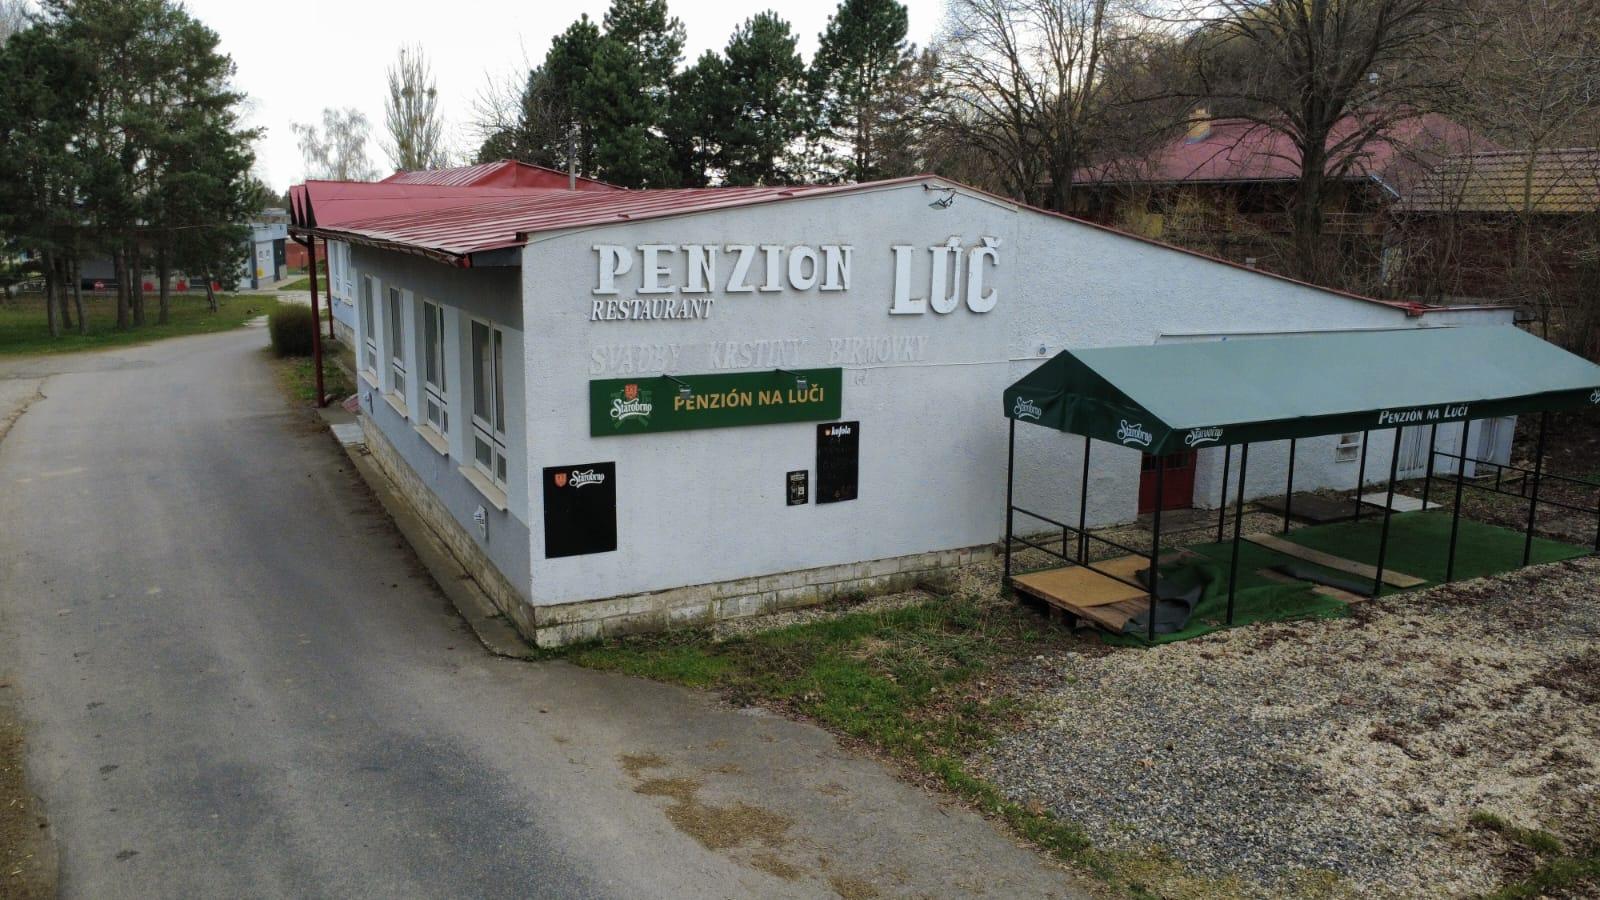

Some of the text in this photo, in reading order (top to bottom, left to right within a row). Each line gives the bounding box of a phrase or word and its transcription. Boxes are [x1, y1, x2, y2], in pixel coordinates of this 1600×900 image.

[591, 236, 1002, 316] PENZION LÚČ
[590, 298, 714, 321] RESTAURANT
[674, 383, 824, 411] PENZIÓN NA LUČI
[610, 398, 652, 420] Starobrno
[569, 469, 605, 488] Starobrno
